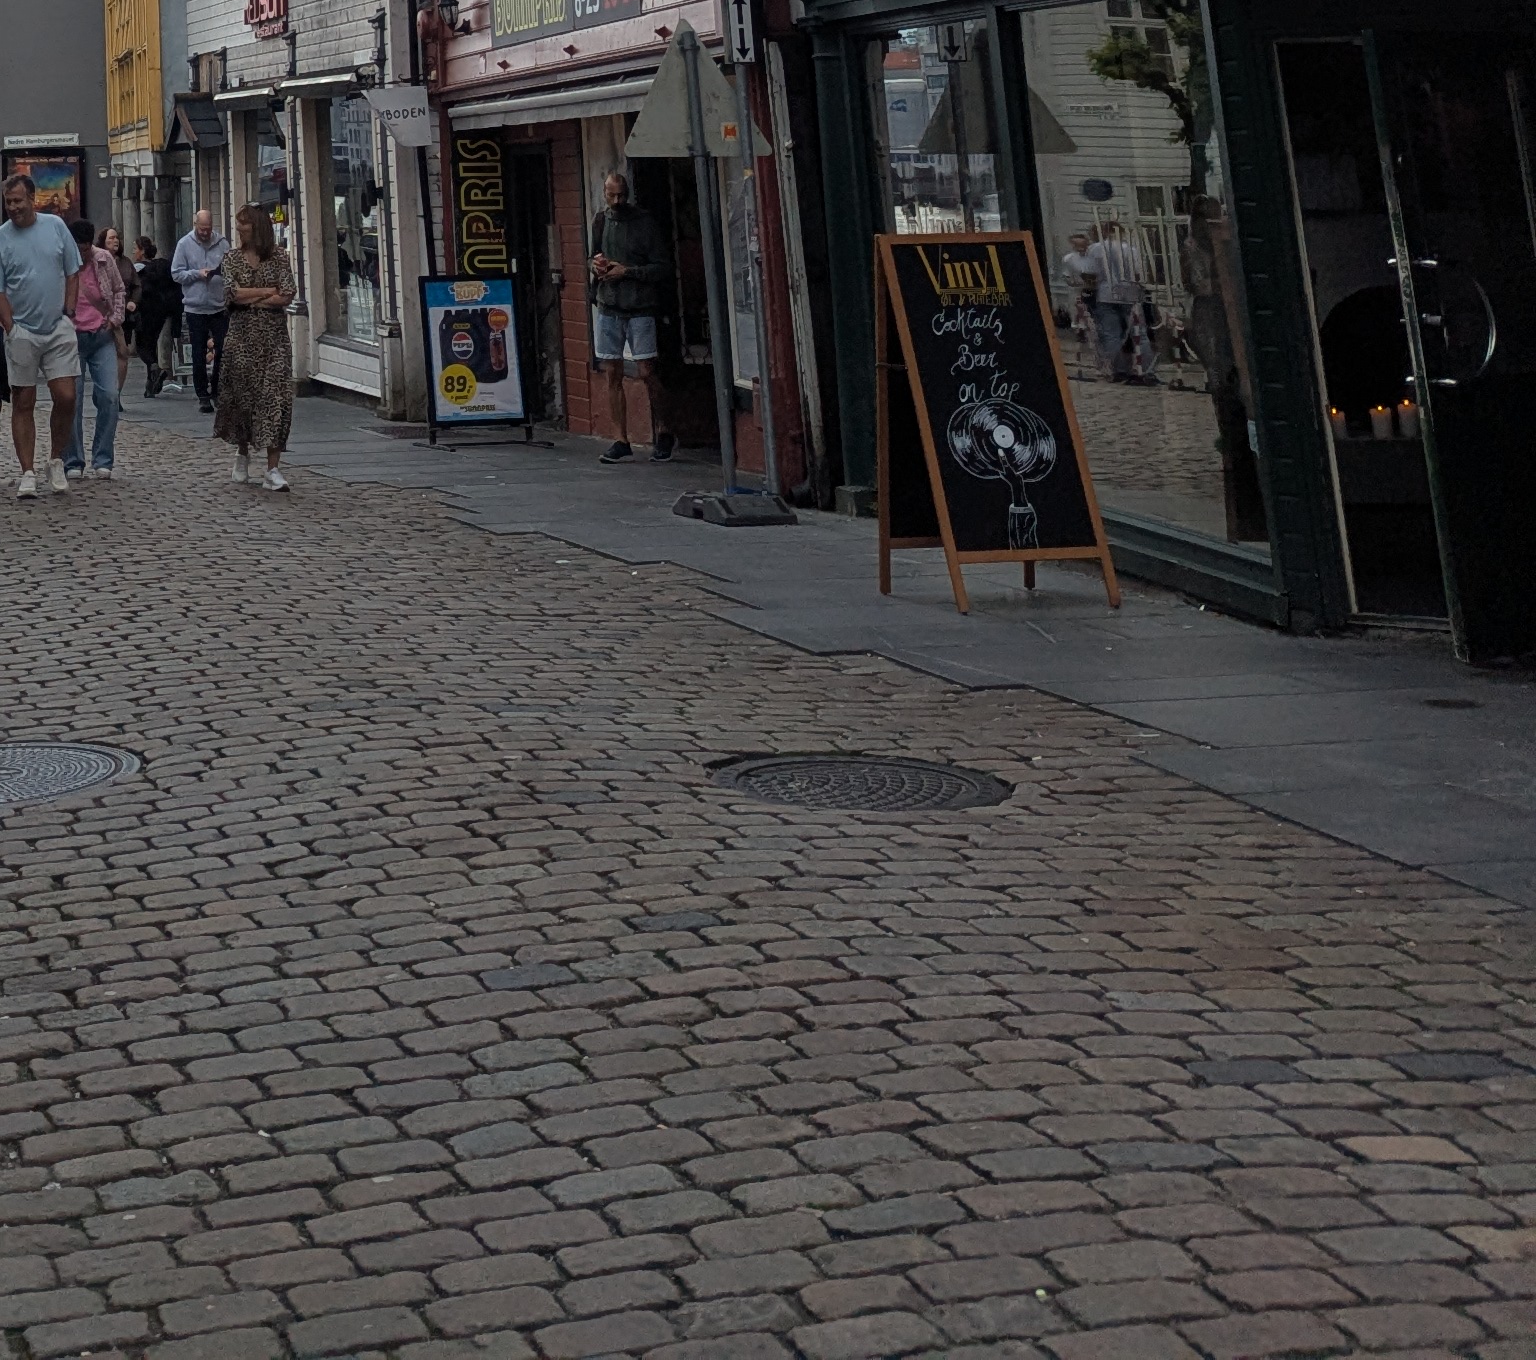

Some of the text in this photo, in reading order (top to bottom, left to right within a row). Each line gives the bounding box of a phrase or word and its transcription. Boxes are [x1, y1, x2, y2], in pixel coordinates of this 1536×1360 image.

[916, 244, 1007, 295] Vinyl
[931, 307, 1006, 344] Cocktails
[973, 333, 983, 346] &
[950, 344, 999, 376] Beer
[959, 383, 985, 403] on
